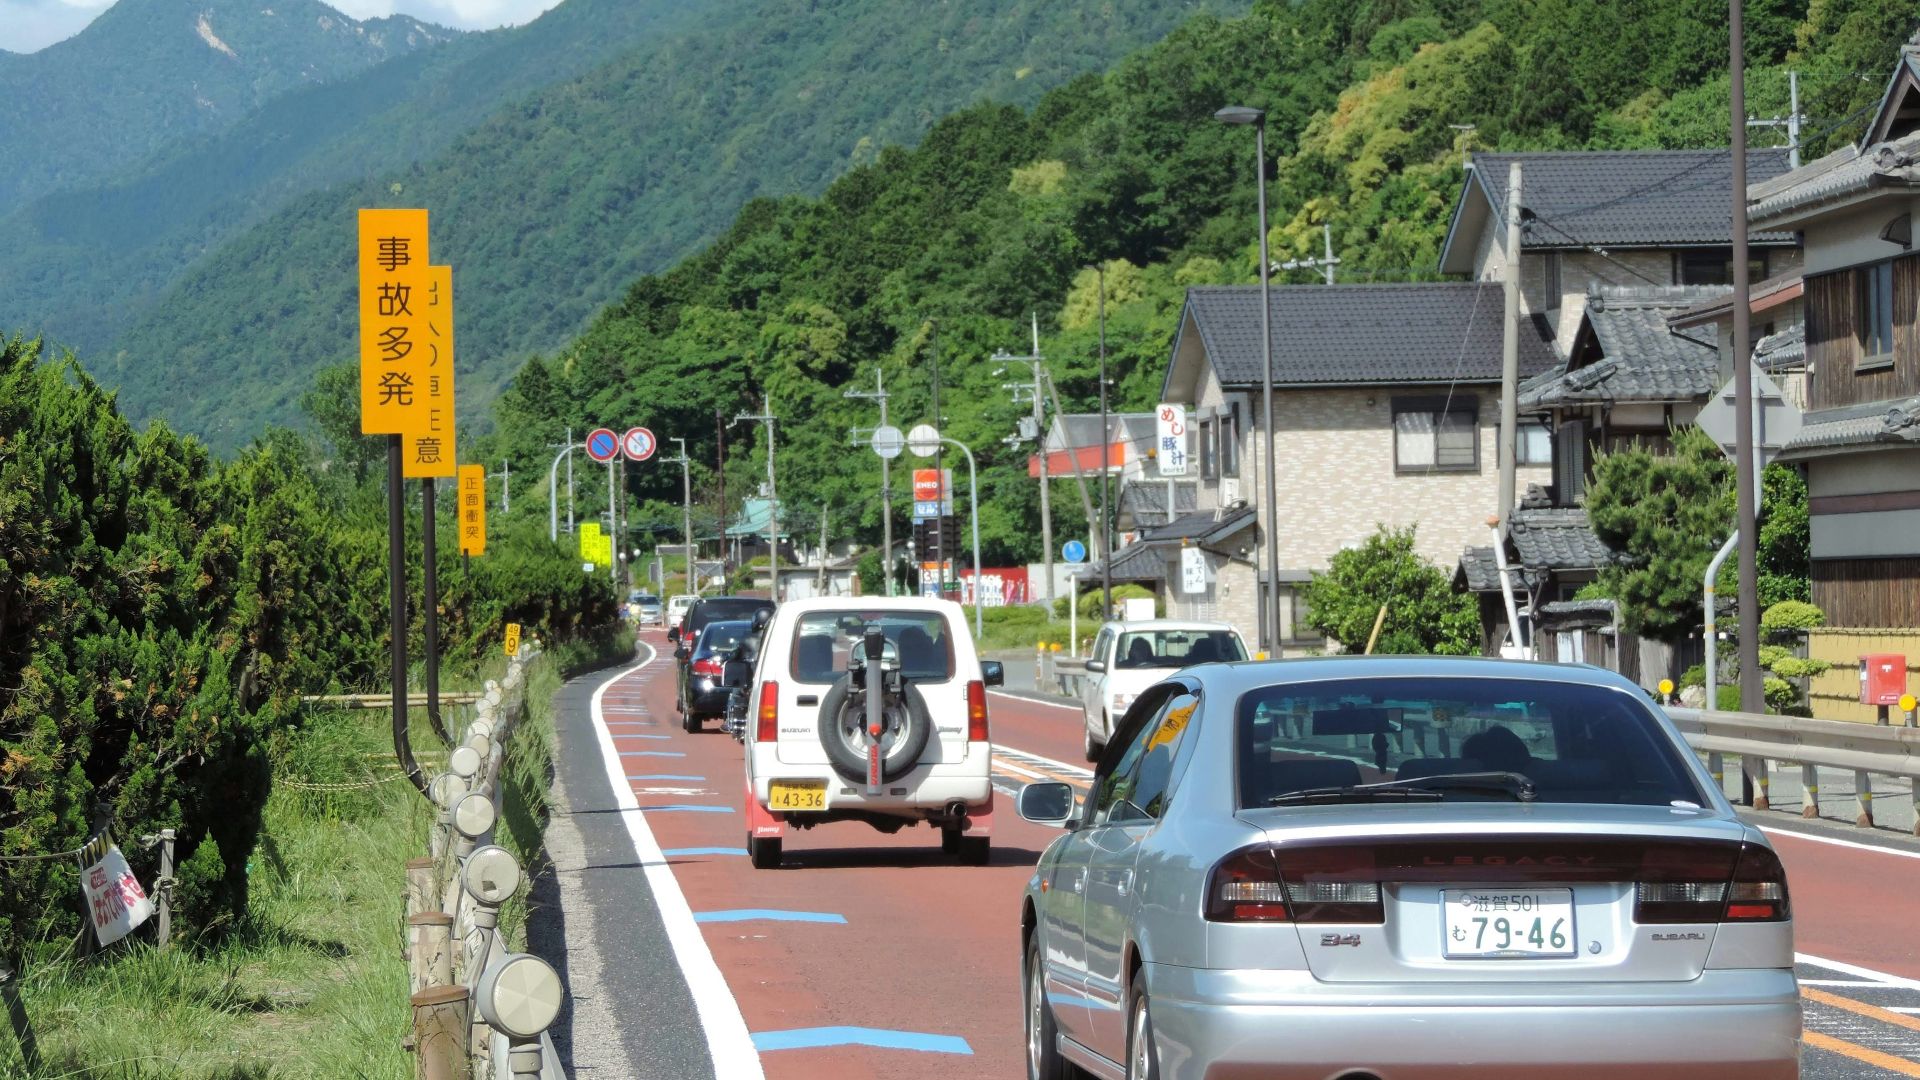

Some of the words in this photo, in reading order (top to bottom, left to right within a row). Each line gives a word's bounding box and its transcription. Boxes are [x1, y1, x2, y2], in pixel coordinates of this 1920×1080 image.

[376, 236, 414, 406] 事故多発
[1161, 408, 1184, 436] めし
[1162, 436, 1184, 465] 豚汁
[916, 481, 938, 489] ENEO
[465, 477, 479, 539] 正面衝突
[508, 637, 516, 653] 9
[783, 793, 822, 806] 43-36
[1423, 856, 1596, 865] LEGACY
[1473, 895, 1540, 912] 滋賀501
[1320, 933, 1361, 947] B4
[1452, 925, 1467, 941] む
[1471, 916, 1566, 949] 79-46
[1651, 933, 1705, 941] SUBARU
